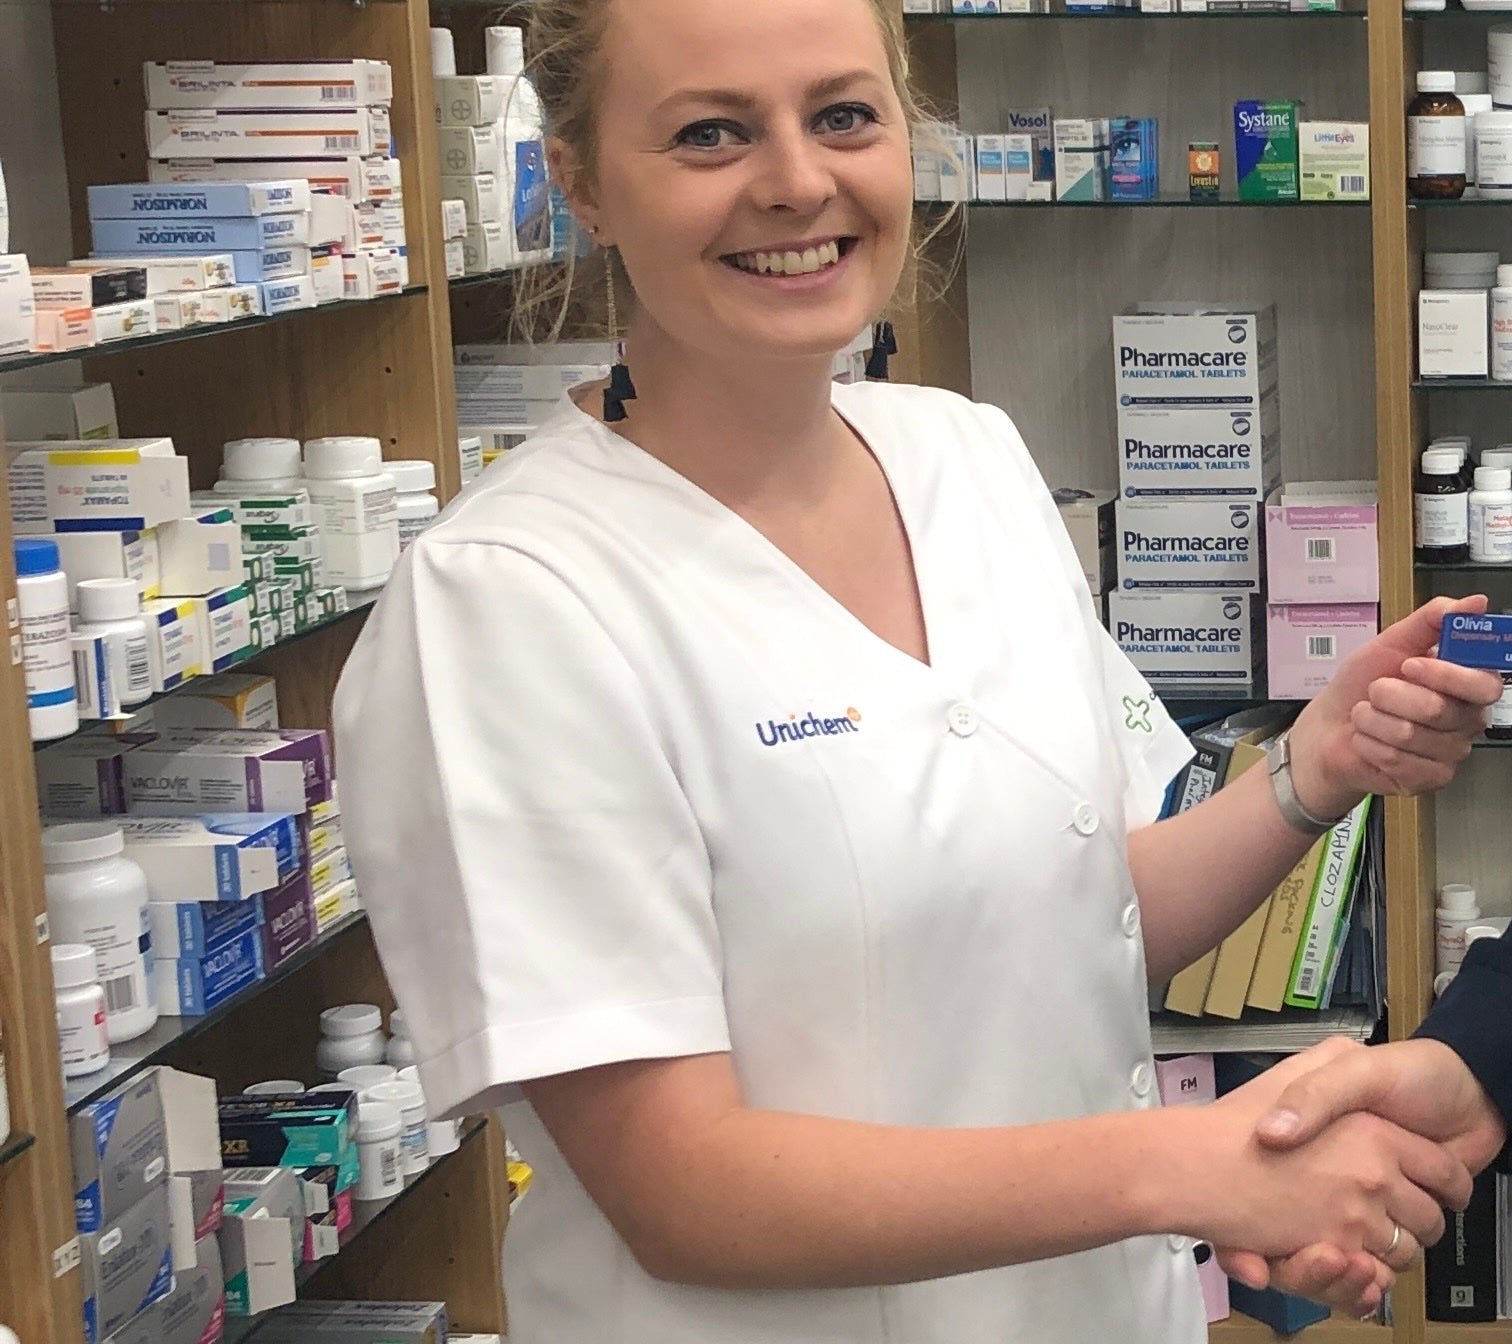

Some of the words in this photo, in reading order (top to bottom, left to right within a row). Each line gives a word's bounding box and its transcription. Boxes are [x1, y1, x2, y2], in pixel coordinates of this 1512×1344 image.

[178, 80, 236, 88] BRILINTA
[1010, 113, 1047, 128] Vosol
[181, 130, 239, 138] BRILINTA
[133, 197, 208, 211] NORMISON
[137, 230, 216, 244] NORMISON
[1120, 346, 1247, 367] Pharmacare
[1122, 369, 1198, 378] PARACETAMOL
[1201, 369, 1247, 378] TABLETS
[1125, 439, 1251, 459] Pharmacare
[1127, 462, 1202, 471] PARACETAMOL
[1206, 461, 1250, 470] TABLETS
[81, 496, 130, 506] TOPAMAX
[1124, 531, 1249, 551] Pharmacare
[1125, 554, 1200, 562] PARACETAMOL
[1204, 553, 1248, 562] TABLETS
[1452, 617, 1492, 632] Olivia
[1117, 622, 1241, 642] Pharmacare
[1451, 631, 1500, 643] Dispensary
[1119, 644, 1193, 653] PARACETAMOL
[1196, 644, 1240, 653] TABLETS
[756, 712, 859, 747] Unichem
[131, 775, 190, 792] VACLOVIR
[1456, 1290, 1466, 1303] 9
